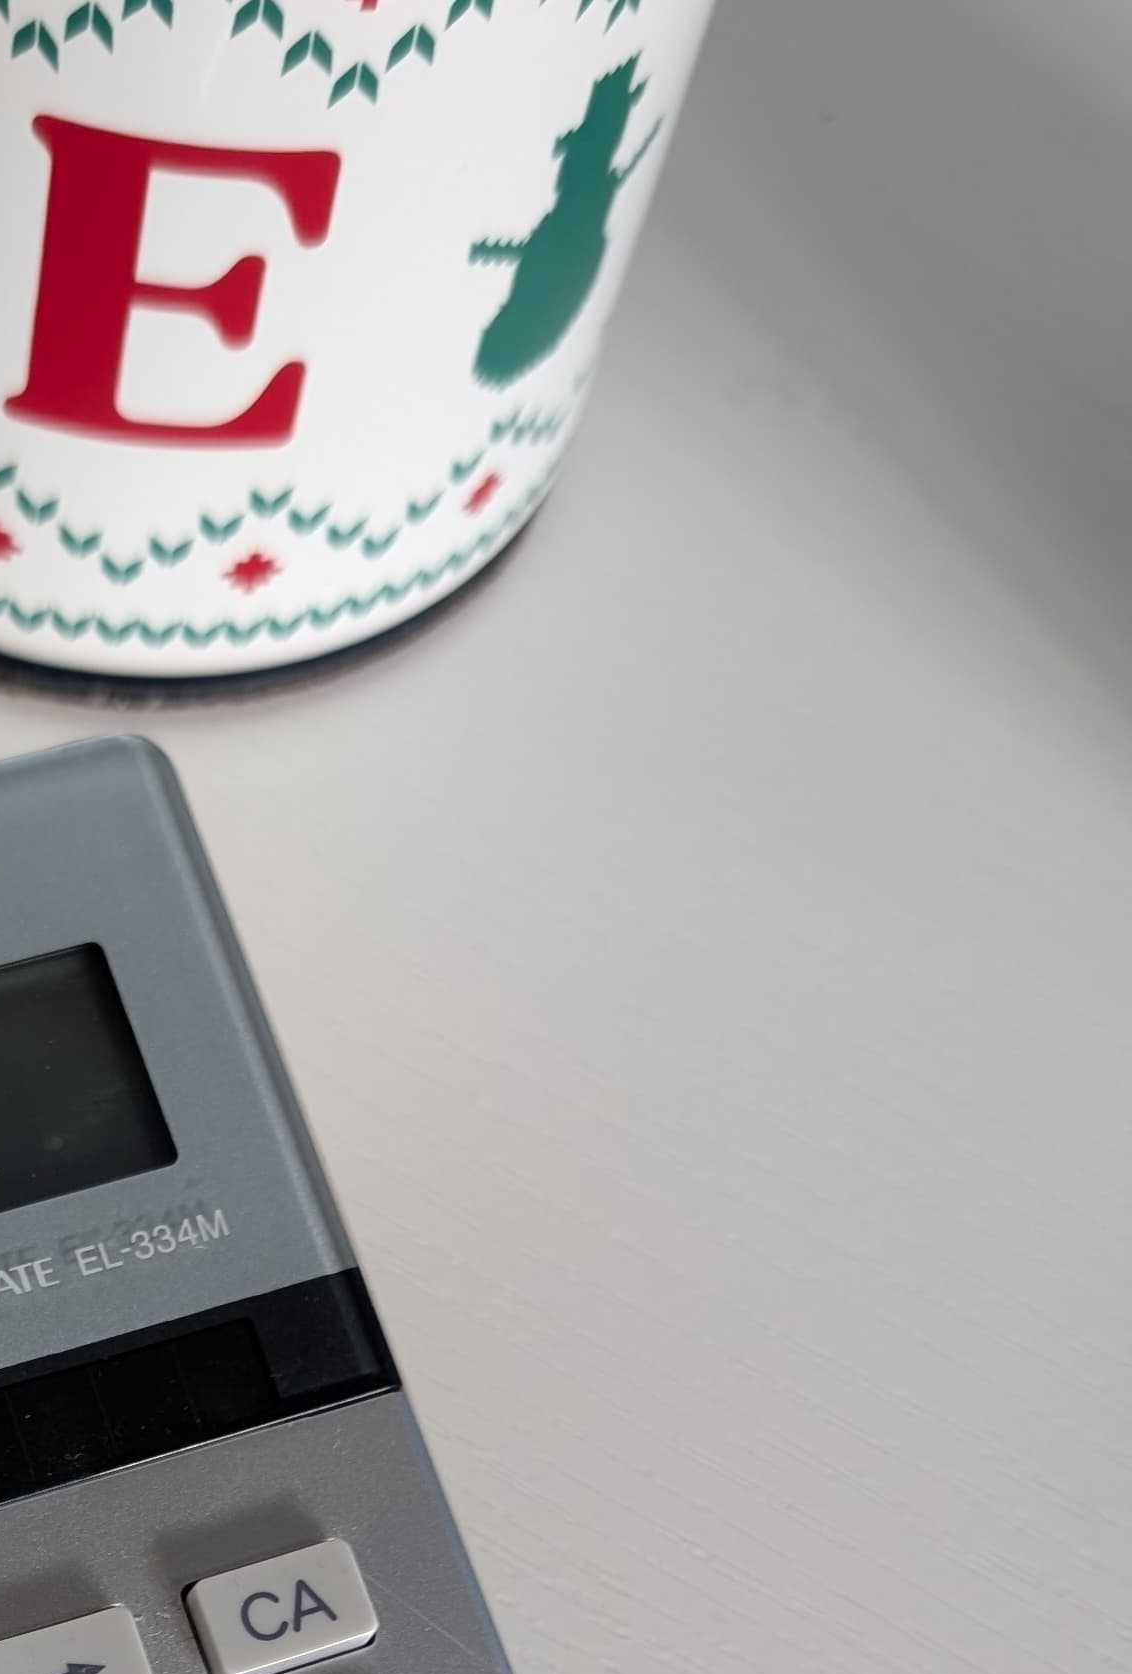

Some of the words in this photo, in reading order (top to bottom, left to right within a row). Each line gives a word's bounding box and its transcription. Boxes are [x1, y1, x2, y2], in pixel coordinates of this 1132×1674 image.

[2, 113, 341, 450] E
[75, 1209, 229, 1276] EL-334M
[240, 1579, 337, 1641] CA
